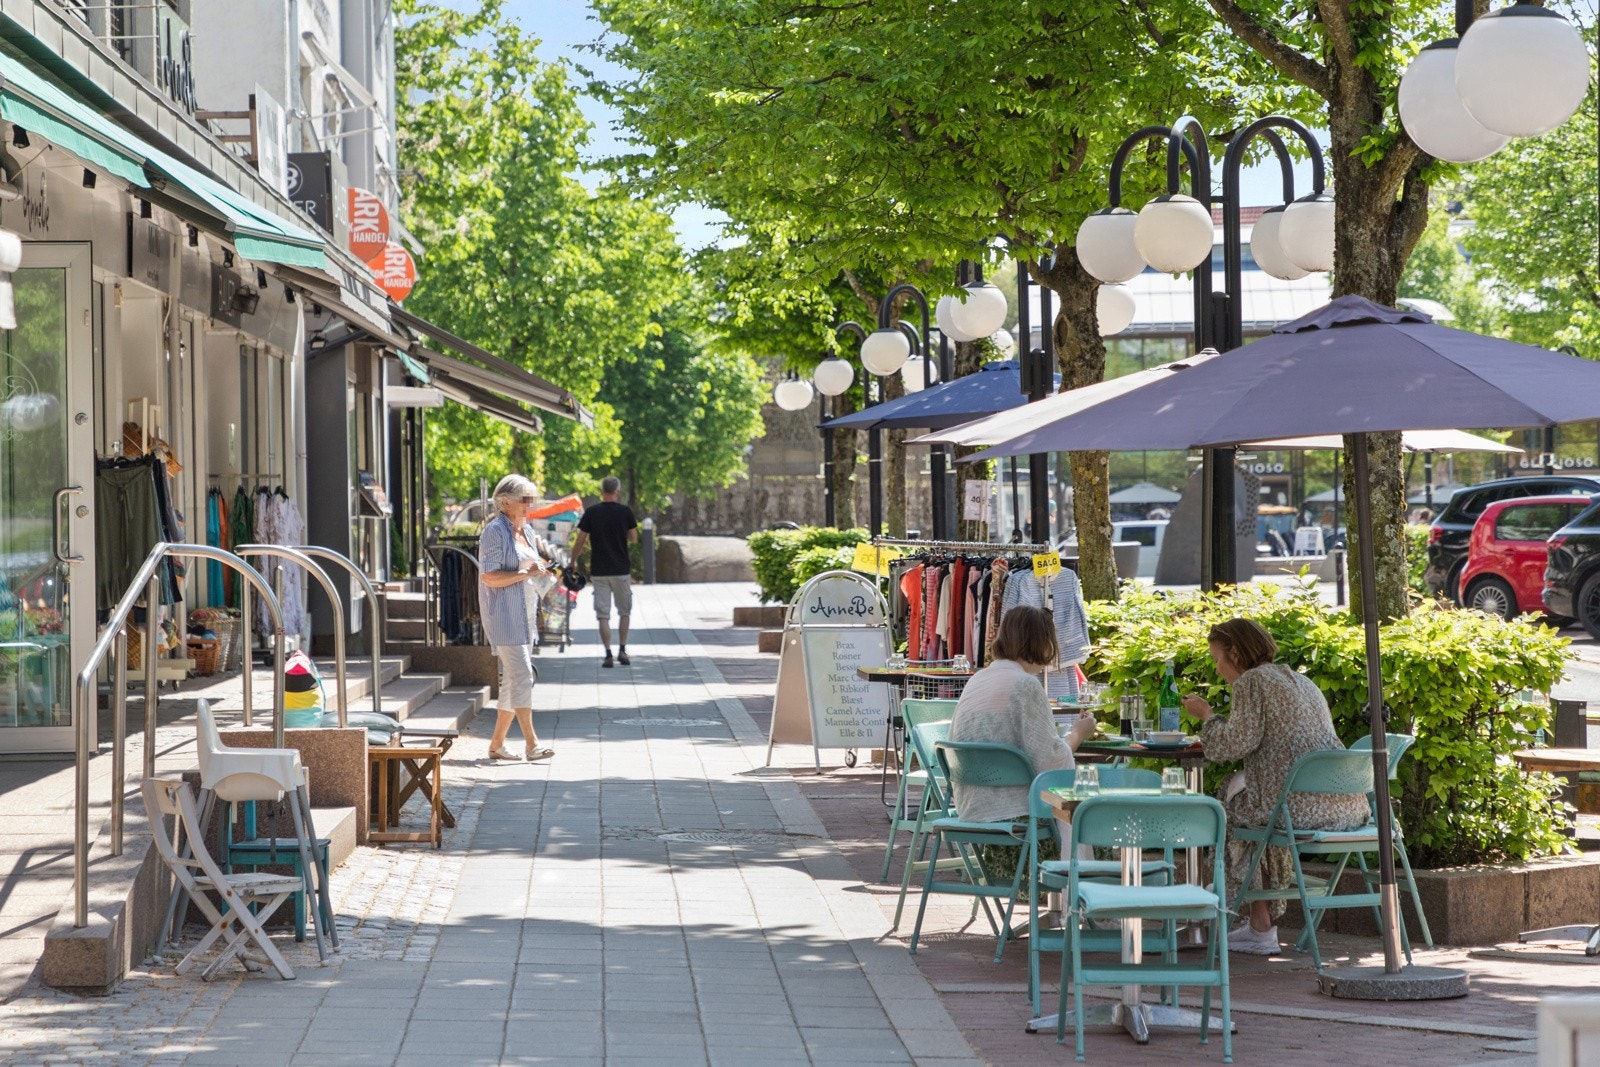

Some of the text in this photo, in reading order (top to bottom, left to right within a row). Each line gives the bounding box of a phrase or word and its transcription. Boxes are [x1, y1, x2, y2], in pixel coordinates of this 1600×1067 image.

[294, 200, 316, 215] ER
[354, 188, 380, 232] ARK
[353, 232, 387, 243] HANDEL
[384, 241, 407, 279] ARK
[384, 278, 413, 288] HANDEL
[1520, 457, 1593, 468] GLIOSO
[1240, 463, 1284, 473] IOSO
[1037, 558, 1057, 568] SALG
[810, 596, 874, 617] AnneBe
[836, 641, 855, 649] Brax
[832, 652, 861, 660] Rosner
[828, 674, 848, 682] Marc
[832, 684, 870, 694] J. Ribkoff
[826, 706, 881, 715] Camel Active
[824, 718, 885, 727] Manuela Conti
[840, 728, 856, 737] Elle
[857, 729, 865, 737] &
